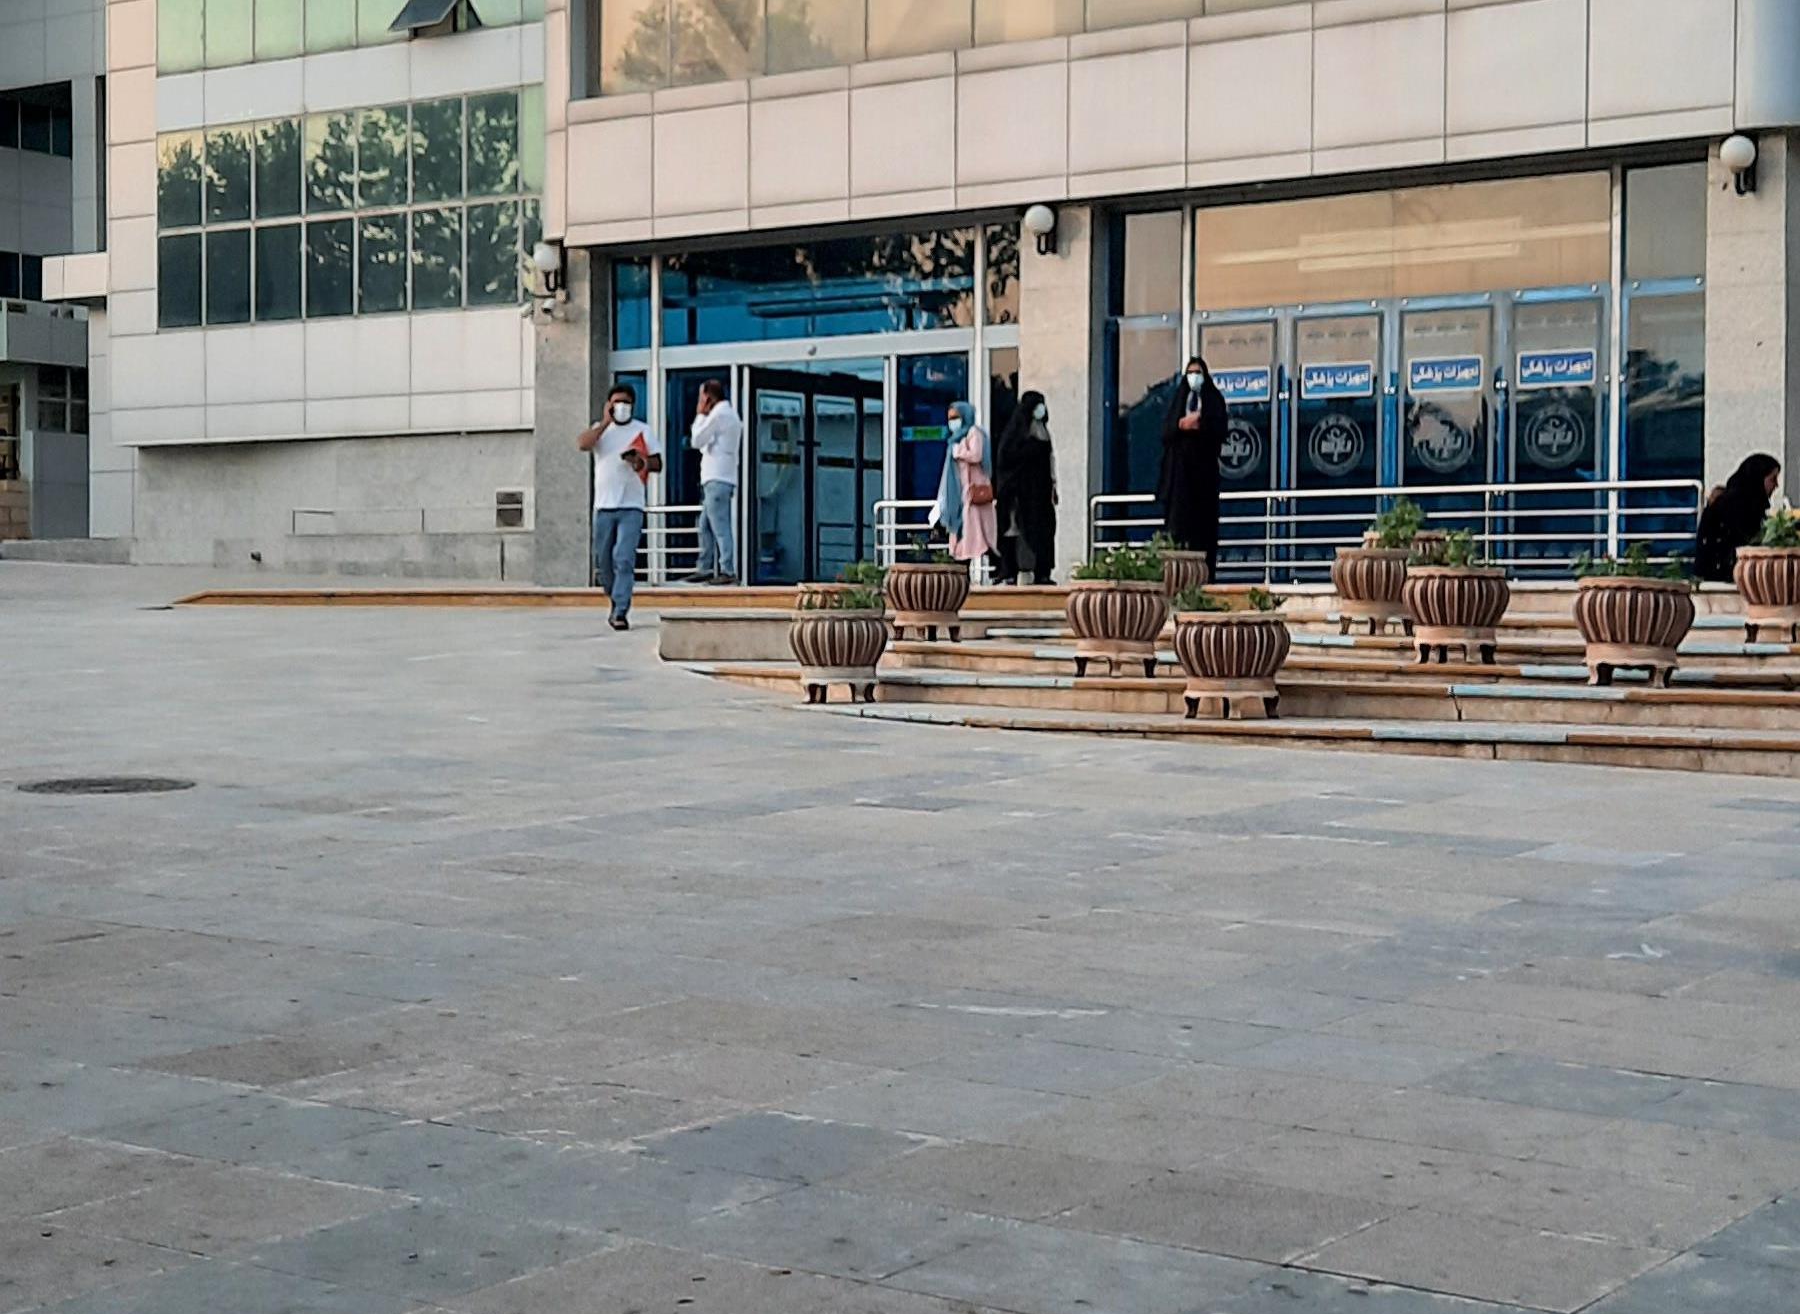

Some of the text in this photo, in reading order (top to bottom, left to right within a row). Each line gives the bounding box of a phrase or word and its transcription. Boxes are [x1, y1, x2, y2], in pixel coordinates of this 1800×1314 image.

[1412, 366, 1443, 384] پزشکی
[1521, 359, 1553, 379] پزشکی
[1212, 377, 1234, 392] پزشک
[1304, 371, 1334, 390] پزشکی
